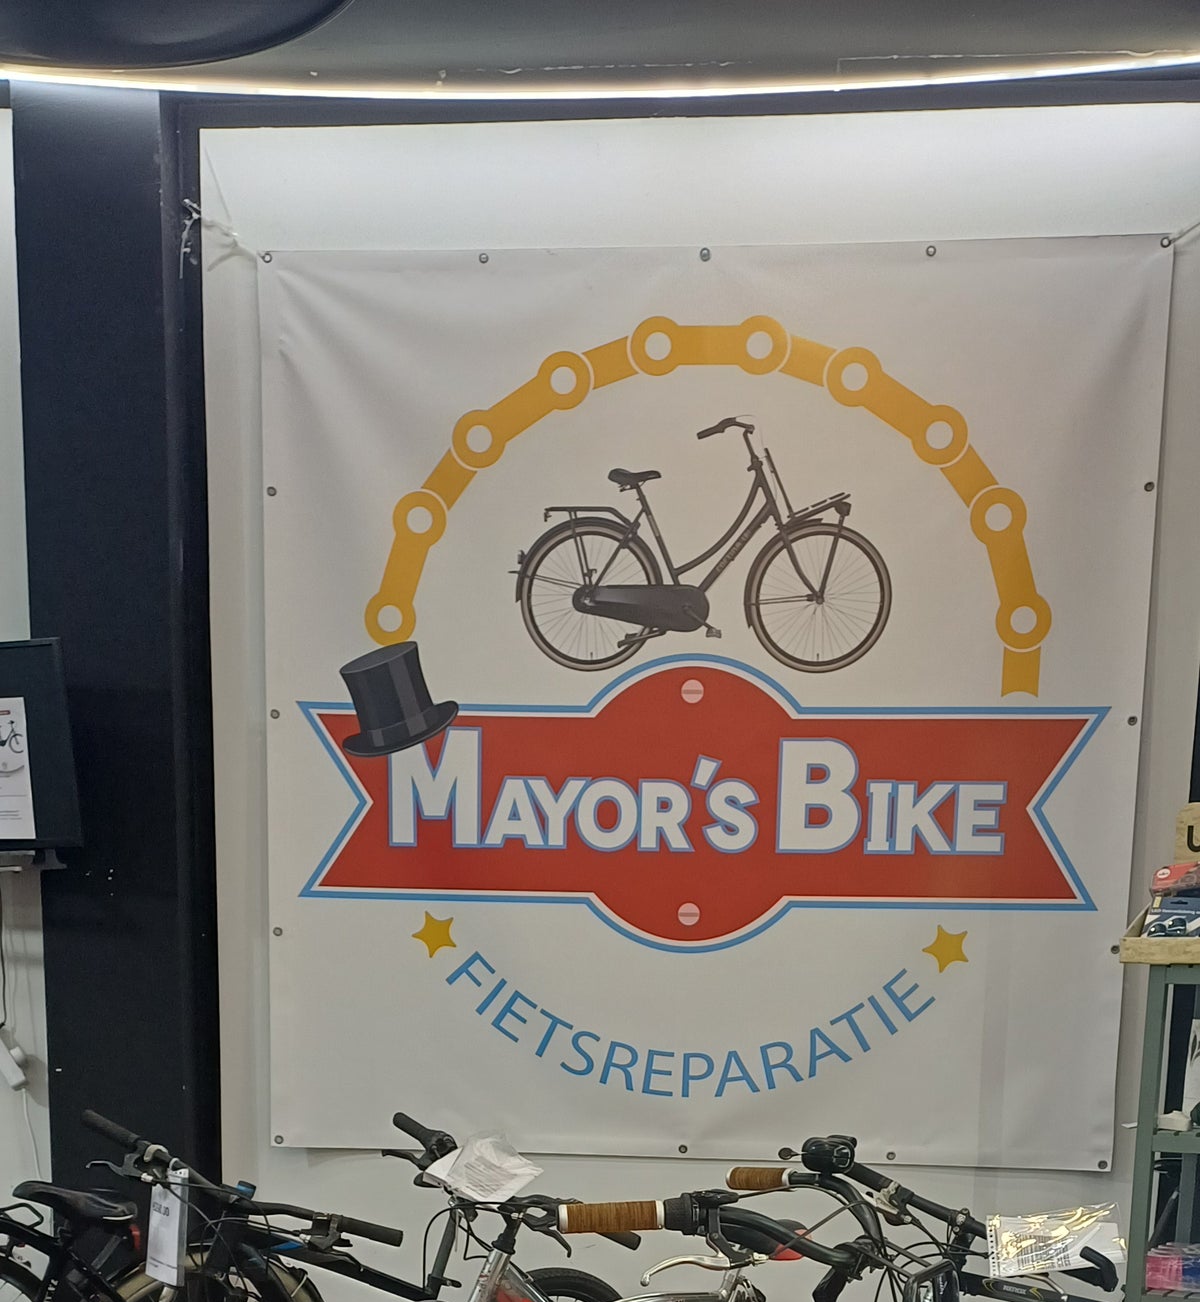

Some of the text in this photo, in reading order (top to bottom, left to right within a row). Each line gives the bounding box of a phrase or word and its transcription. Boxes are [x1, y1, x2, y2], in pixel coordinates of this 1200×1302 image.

[387, 726, 1008, 856] MAYOR'S BIKE
[445, 951, 936, 1098] FIETSREPARATIE
